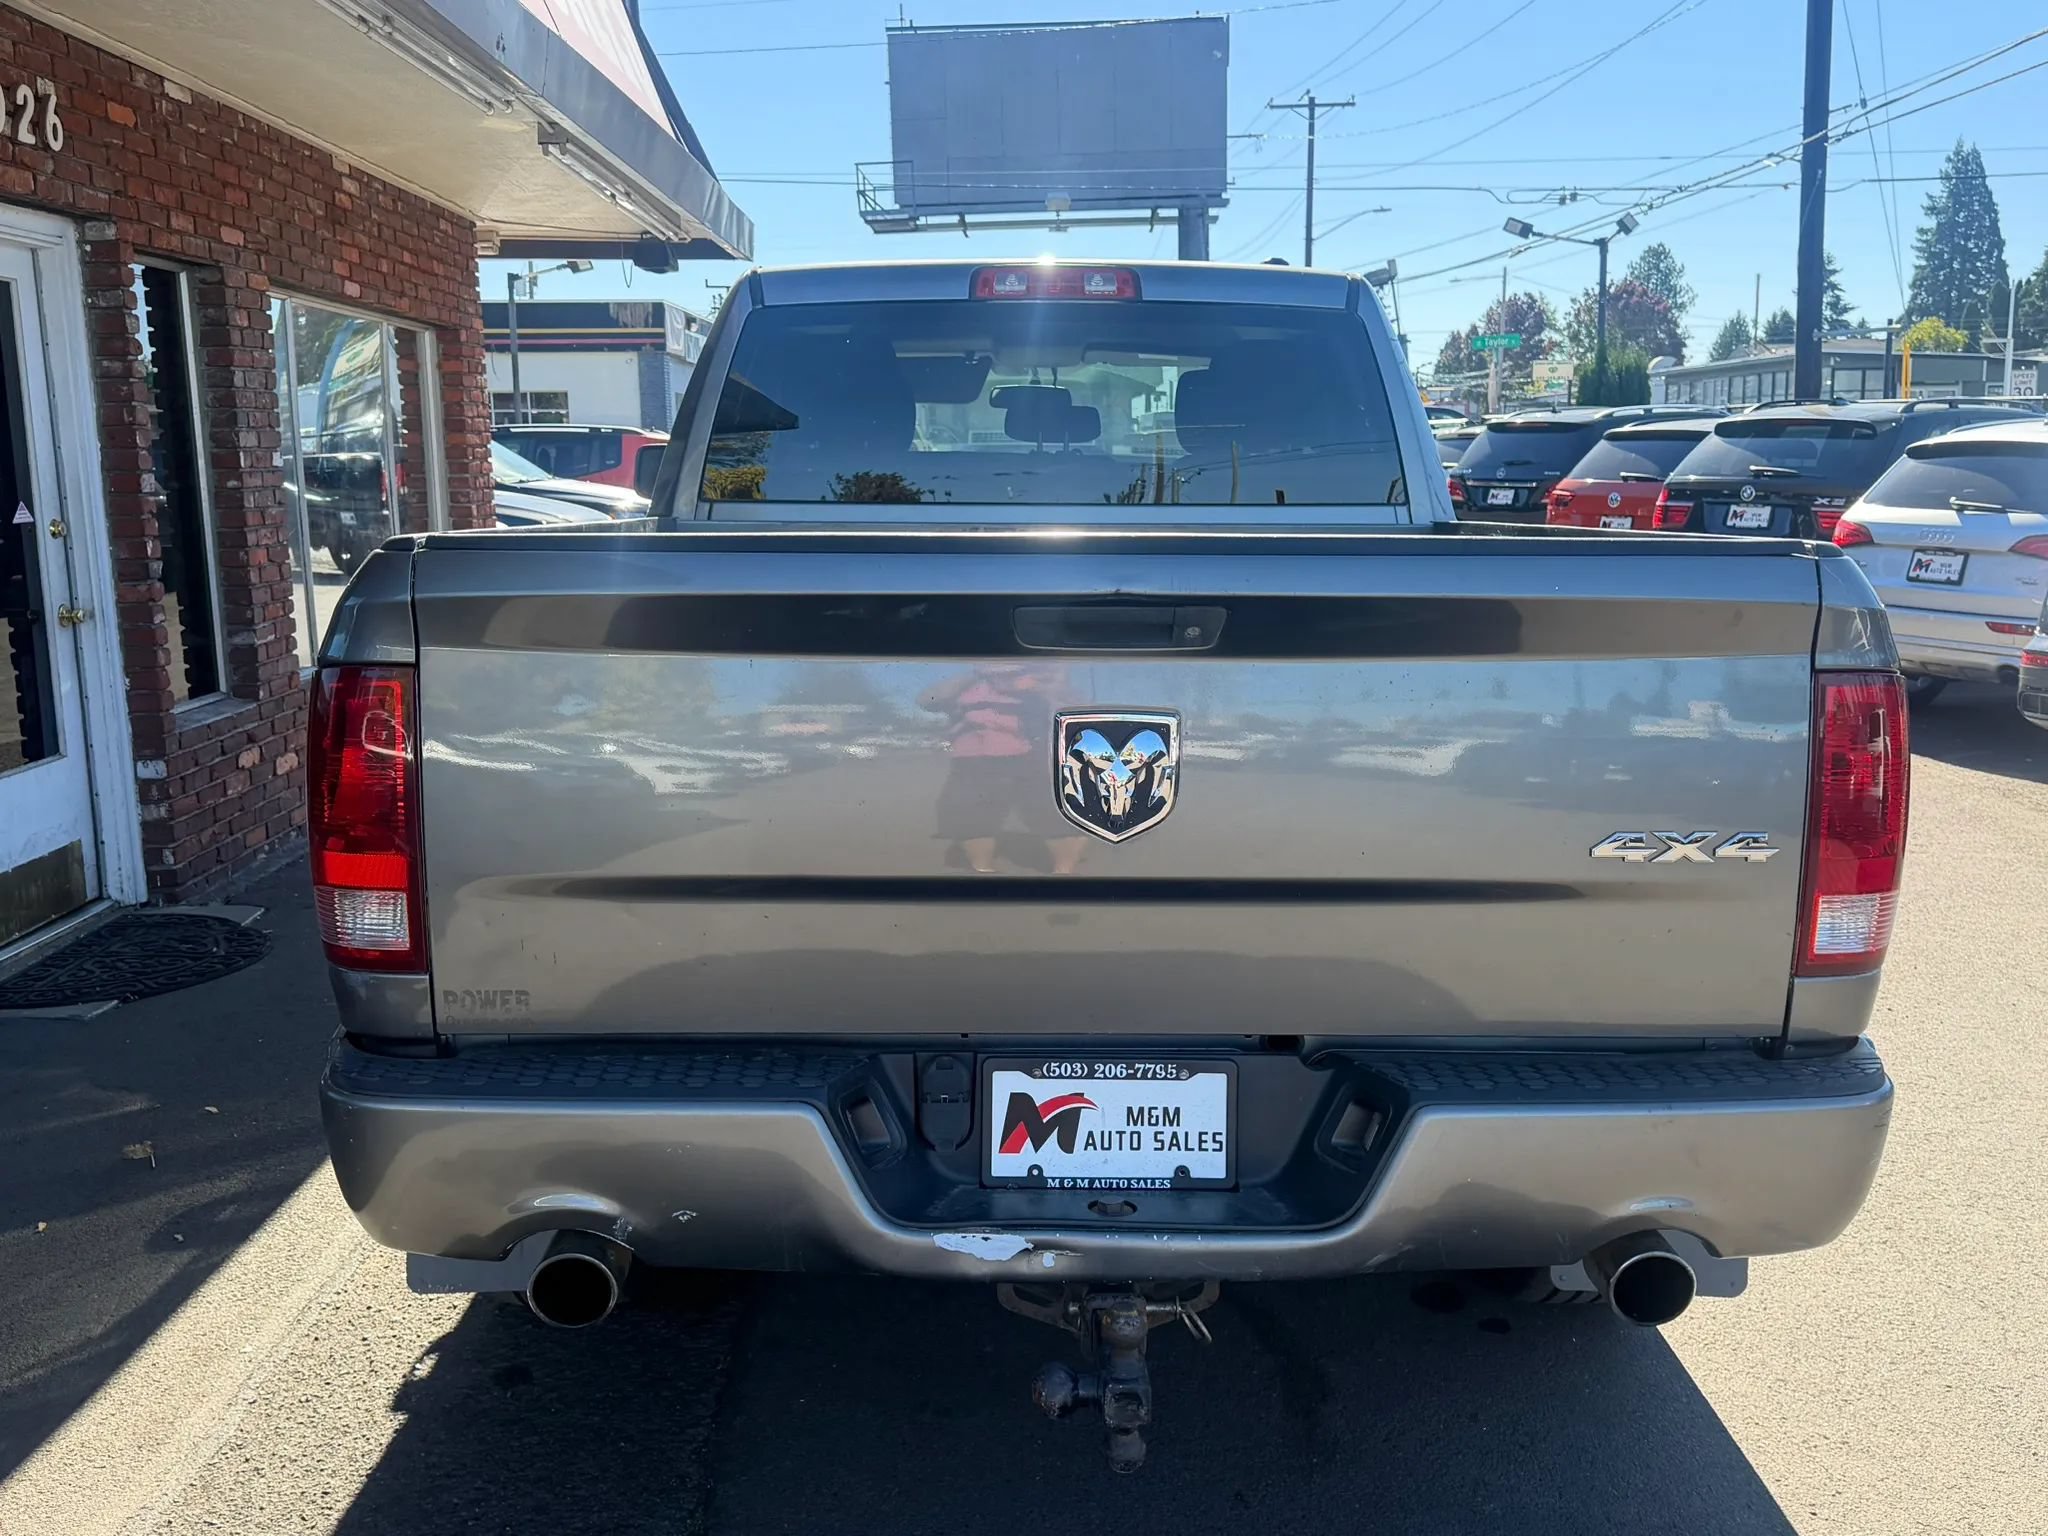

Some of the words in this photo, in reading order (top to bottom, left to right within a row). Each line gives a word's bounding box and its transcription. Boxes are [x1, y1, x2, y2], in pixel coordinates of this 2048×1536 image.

[1484, 337, 1509, 348] Taylor
[2013, 387, 2034, 396] 30
[1589, 830, 1780, 863] 4X4
[443, 990, 531, 1013] POWER
[1042, 1062, 1088, 1078] (503)
[1094, 1063, 1177, 1079] 206-7795
[1126, 1106, 1181, 1127] M&M
[1084, 1130, 1142, 1151] AUTO
[1153, 1131, 1223, 1152] SALES
[1047, 1178, 1061, 1188] M
[1063, 1178, 1074, 1188] &
[1076, 1178, 1090, 1188] M
[1092, 1178, 1129, 1189] AUTO
[1130, 1178, 1171, 1189] SALES
